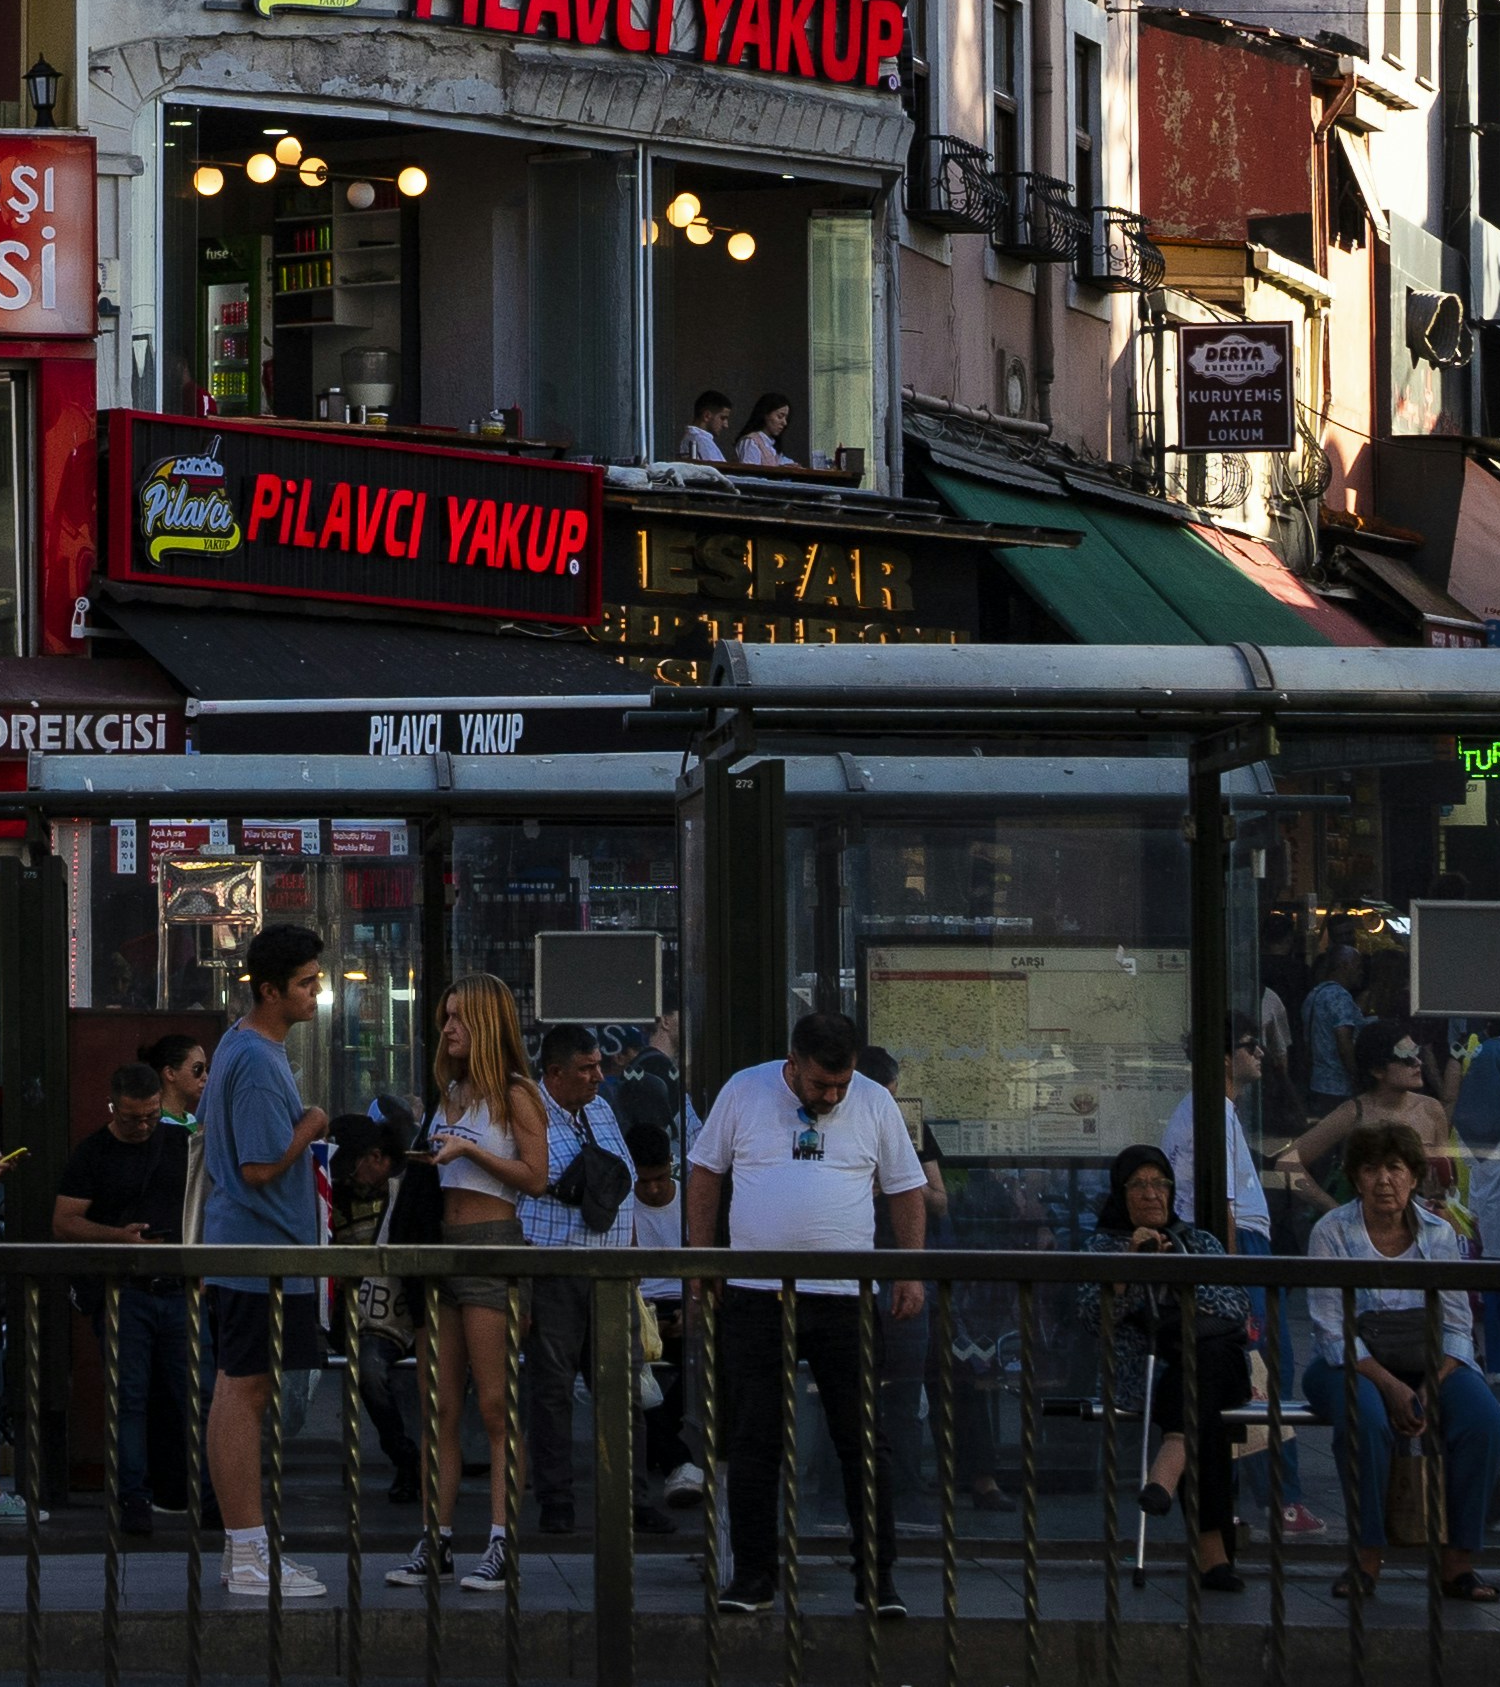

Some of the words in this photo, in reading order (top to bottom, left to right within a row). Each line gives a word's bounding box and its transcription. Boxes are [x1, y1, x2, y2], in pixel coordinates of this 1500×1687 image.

[1205, 347, 1264, 361] DERYA
[1209, 409, 1262, 422] AKTAR
[1208, 429, 1264, 441] LOKUM
[203, 539, 230, 550] YAKUP
[459, 714, 523, 753] YAKUP
[735, 779, 753, 788] 272
[244, 830, 260, 839] Pilav
[151, 840, 169, 850] Pepsi
[1010, 955, 1045, 971] ÇARŞI
